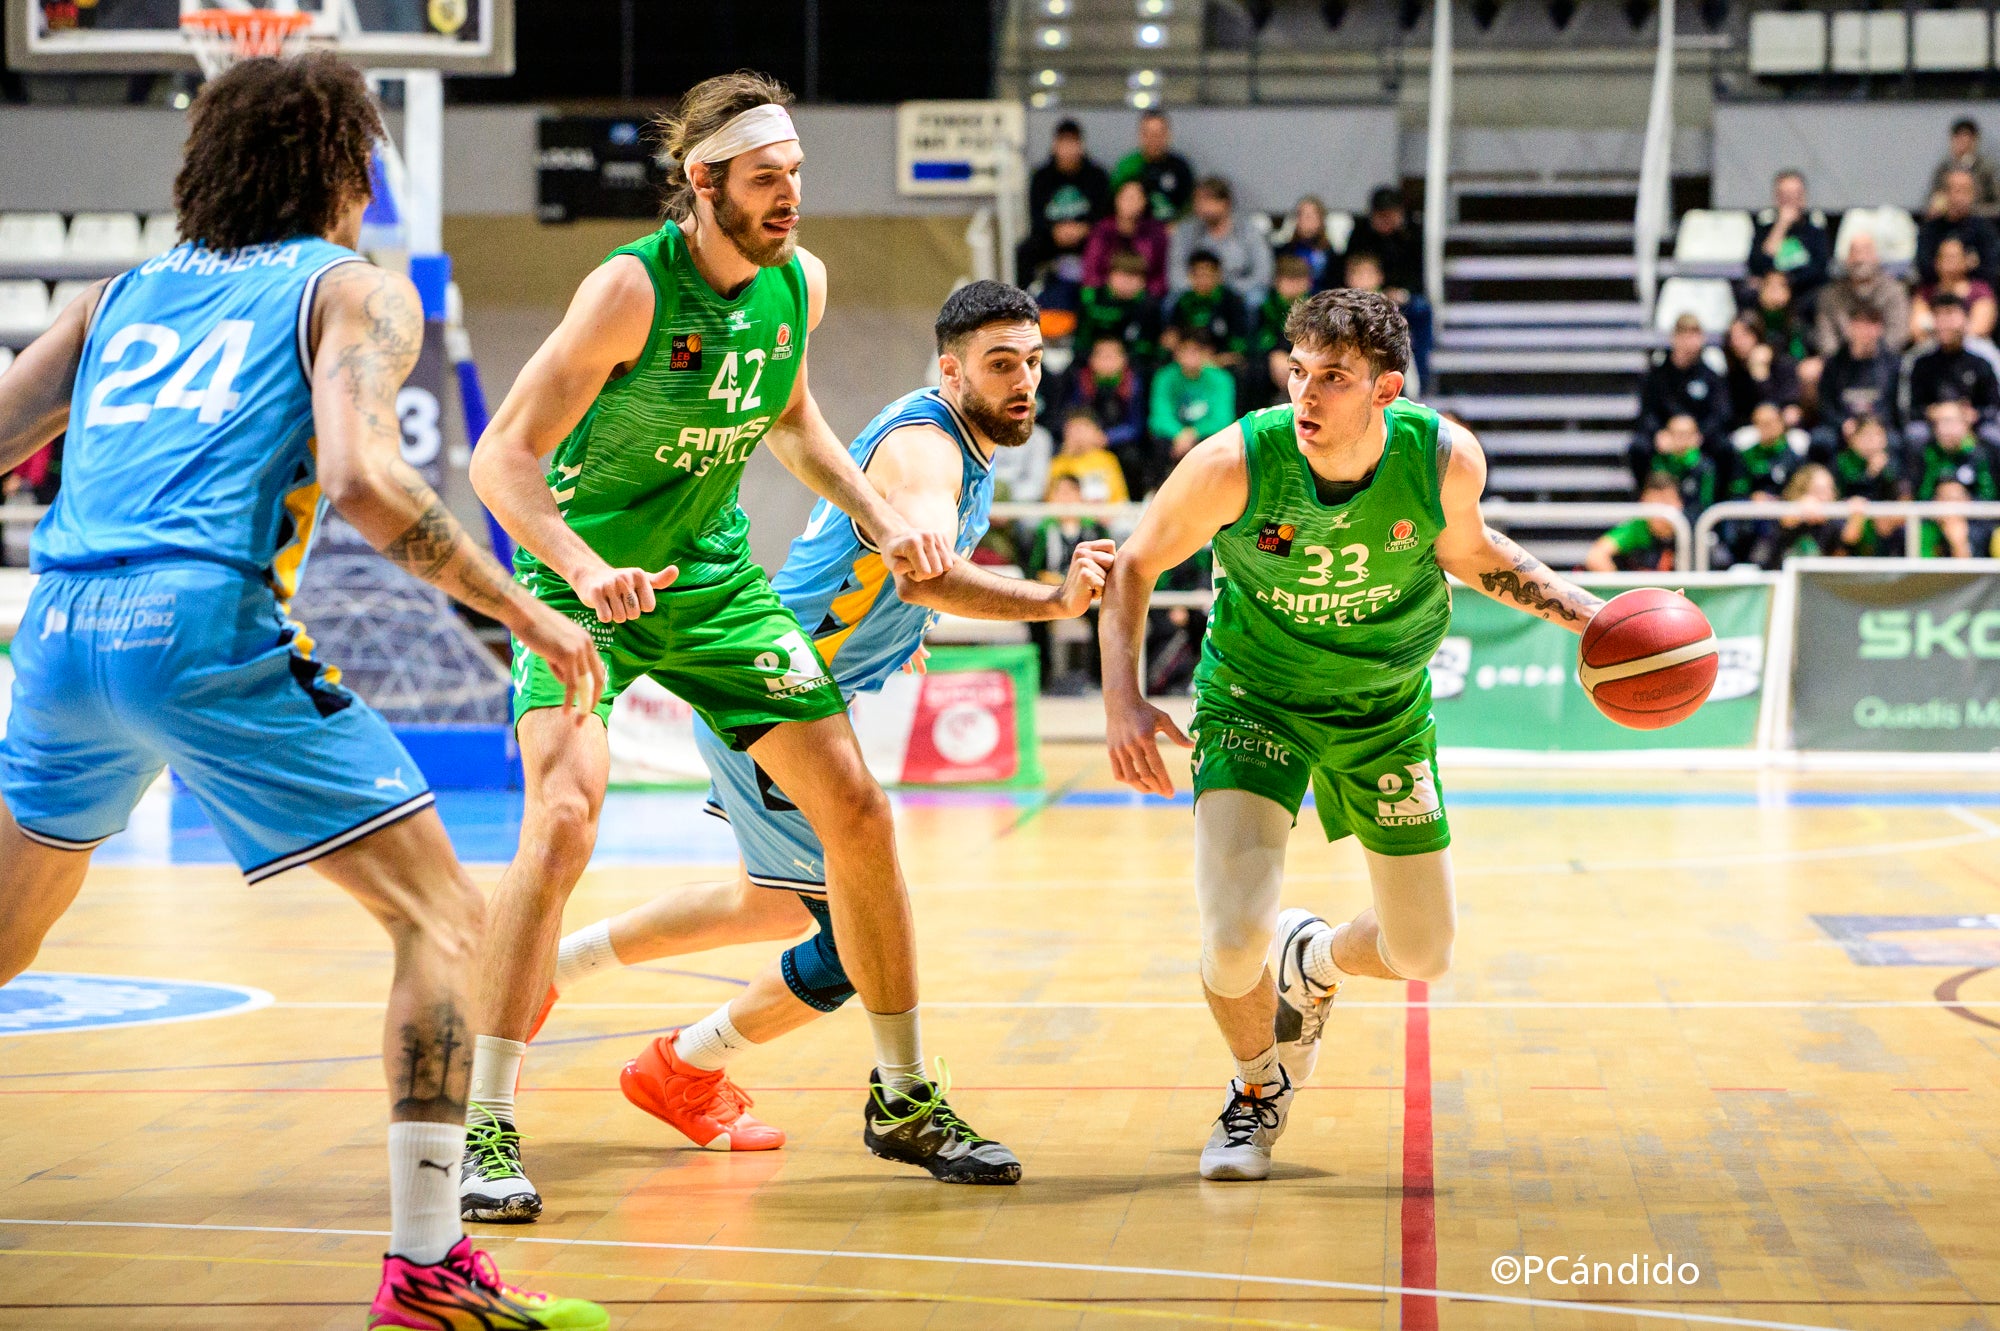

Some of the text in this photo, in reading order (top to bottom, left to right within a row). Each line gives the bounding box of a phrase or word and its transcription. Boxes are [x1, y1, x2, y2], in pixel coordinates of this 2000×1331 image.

[671, 352, 690, 361] LEB
[673, 341, 685, 349] Liga
[84, 319, 255, 430] 24
[671, 361, 688, 369] ORO
[708, 349, 766, 413] 42
[396, 387, 442, 466] 3
[678, 416, 771, 453] AMICS
[1257, 543, 1276, 551] ORO
[1259, 536, 1279, 545] LEB
[1298, 543, 1370, 587] 33
[1271, 584, 1393, 613] AMICS
[1965, 697, 2000, 728] M
[1220, 728, 1290, 766] ibertic
[1234, 753, 1267, 768] telecom
